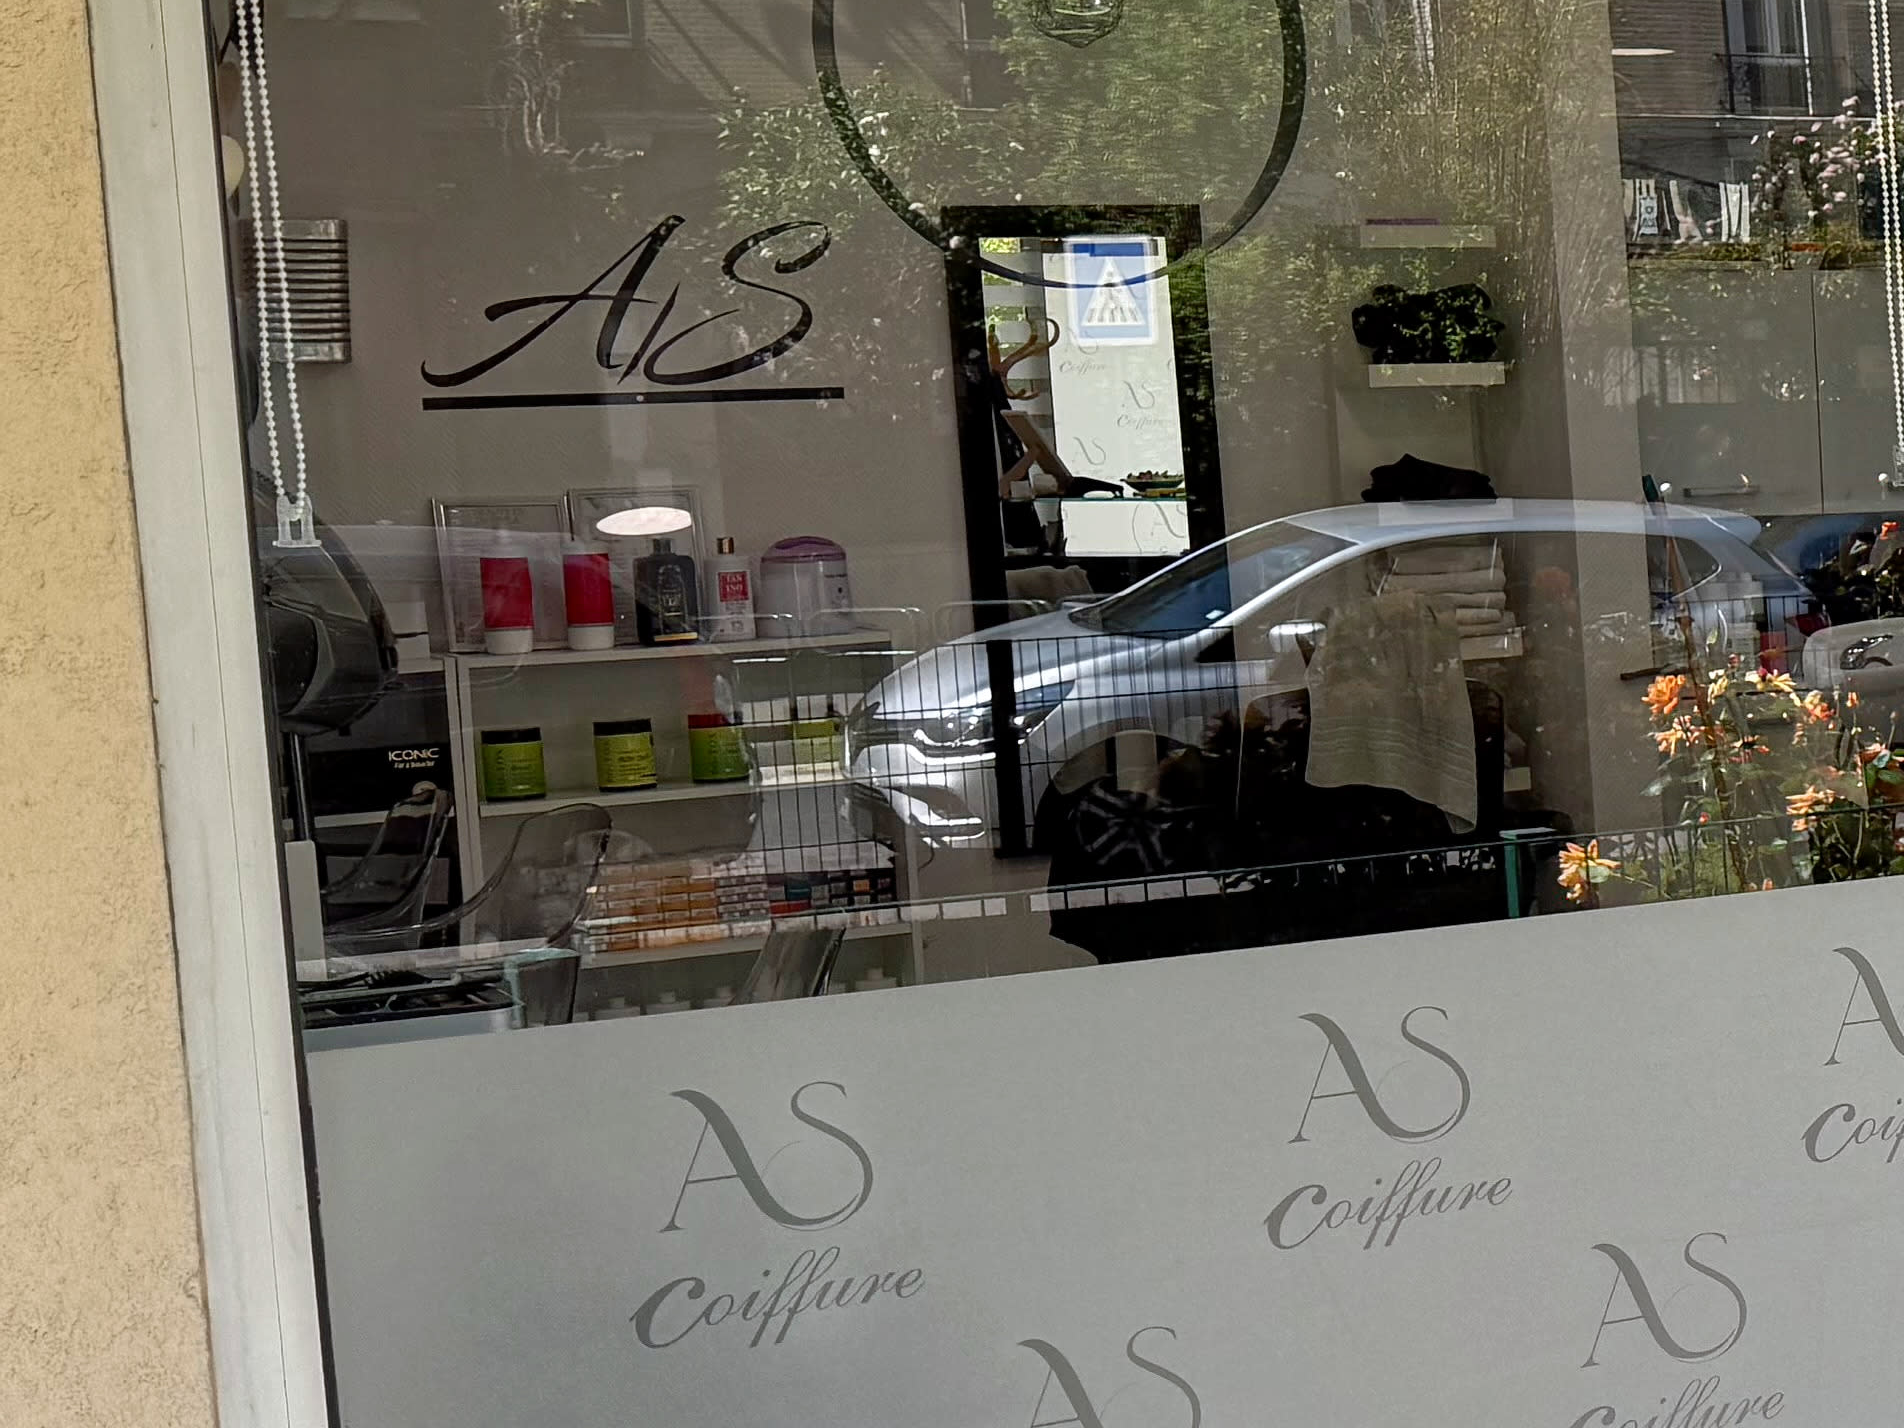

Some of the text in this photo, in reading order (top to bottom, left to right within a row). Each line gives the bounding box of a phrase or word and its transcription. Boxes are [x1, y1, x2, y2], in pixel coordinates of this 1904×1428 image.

[421, 214, 832, 387] AS
[388, 747, 440, 762] ICONIC
[1288, 1006, 1471, 1144] AS
[659, 1081, 874, 1233] AS
[1263, 1157, 1513, 1250] Coiffure
[628, 1246, 925, 1349] Coiffure
[1581, 1232, 1747, 1369] AS
